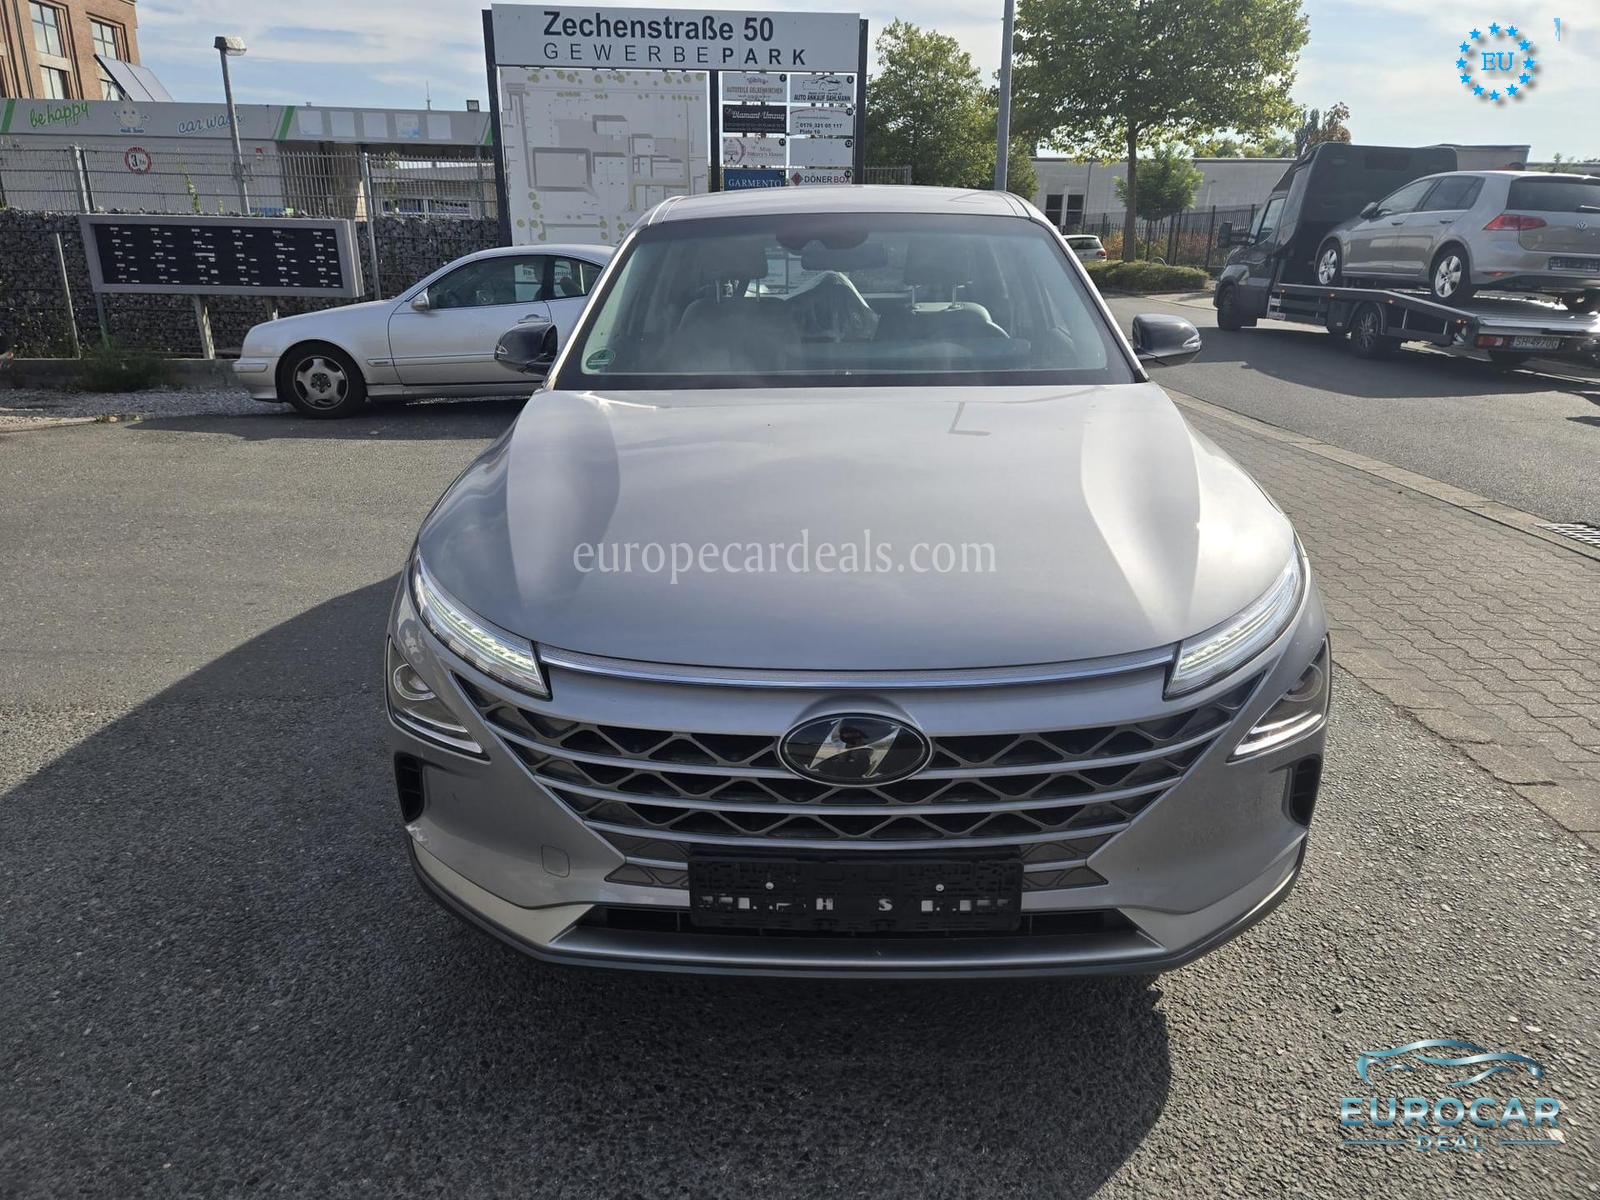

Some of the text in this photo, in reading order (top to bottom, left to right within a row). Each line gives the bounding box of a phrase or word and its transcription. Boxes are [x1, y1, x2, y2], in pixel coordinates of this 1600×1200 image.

[544, 11, 774, 41] Zechenstraße 50
[543, 42, 806, 65] GEWERBEPARK
[29, 101, 89, 127] be happy
[178, 119, 203, 134] car
[728, 179, 782, 188] GARMENTO
